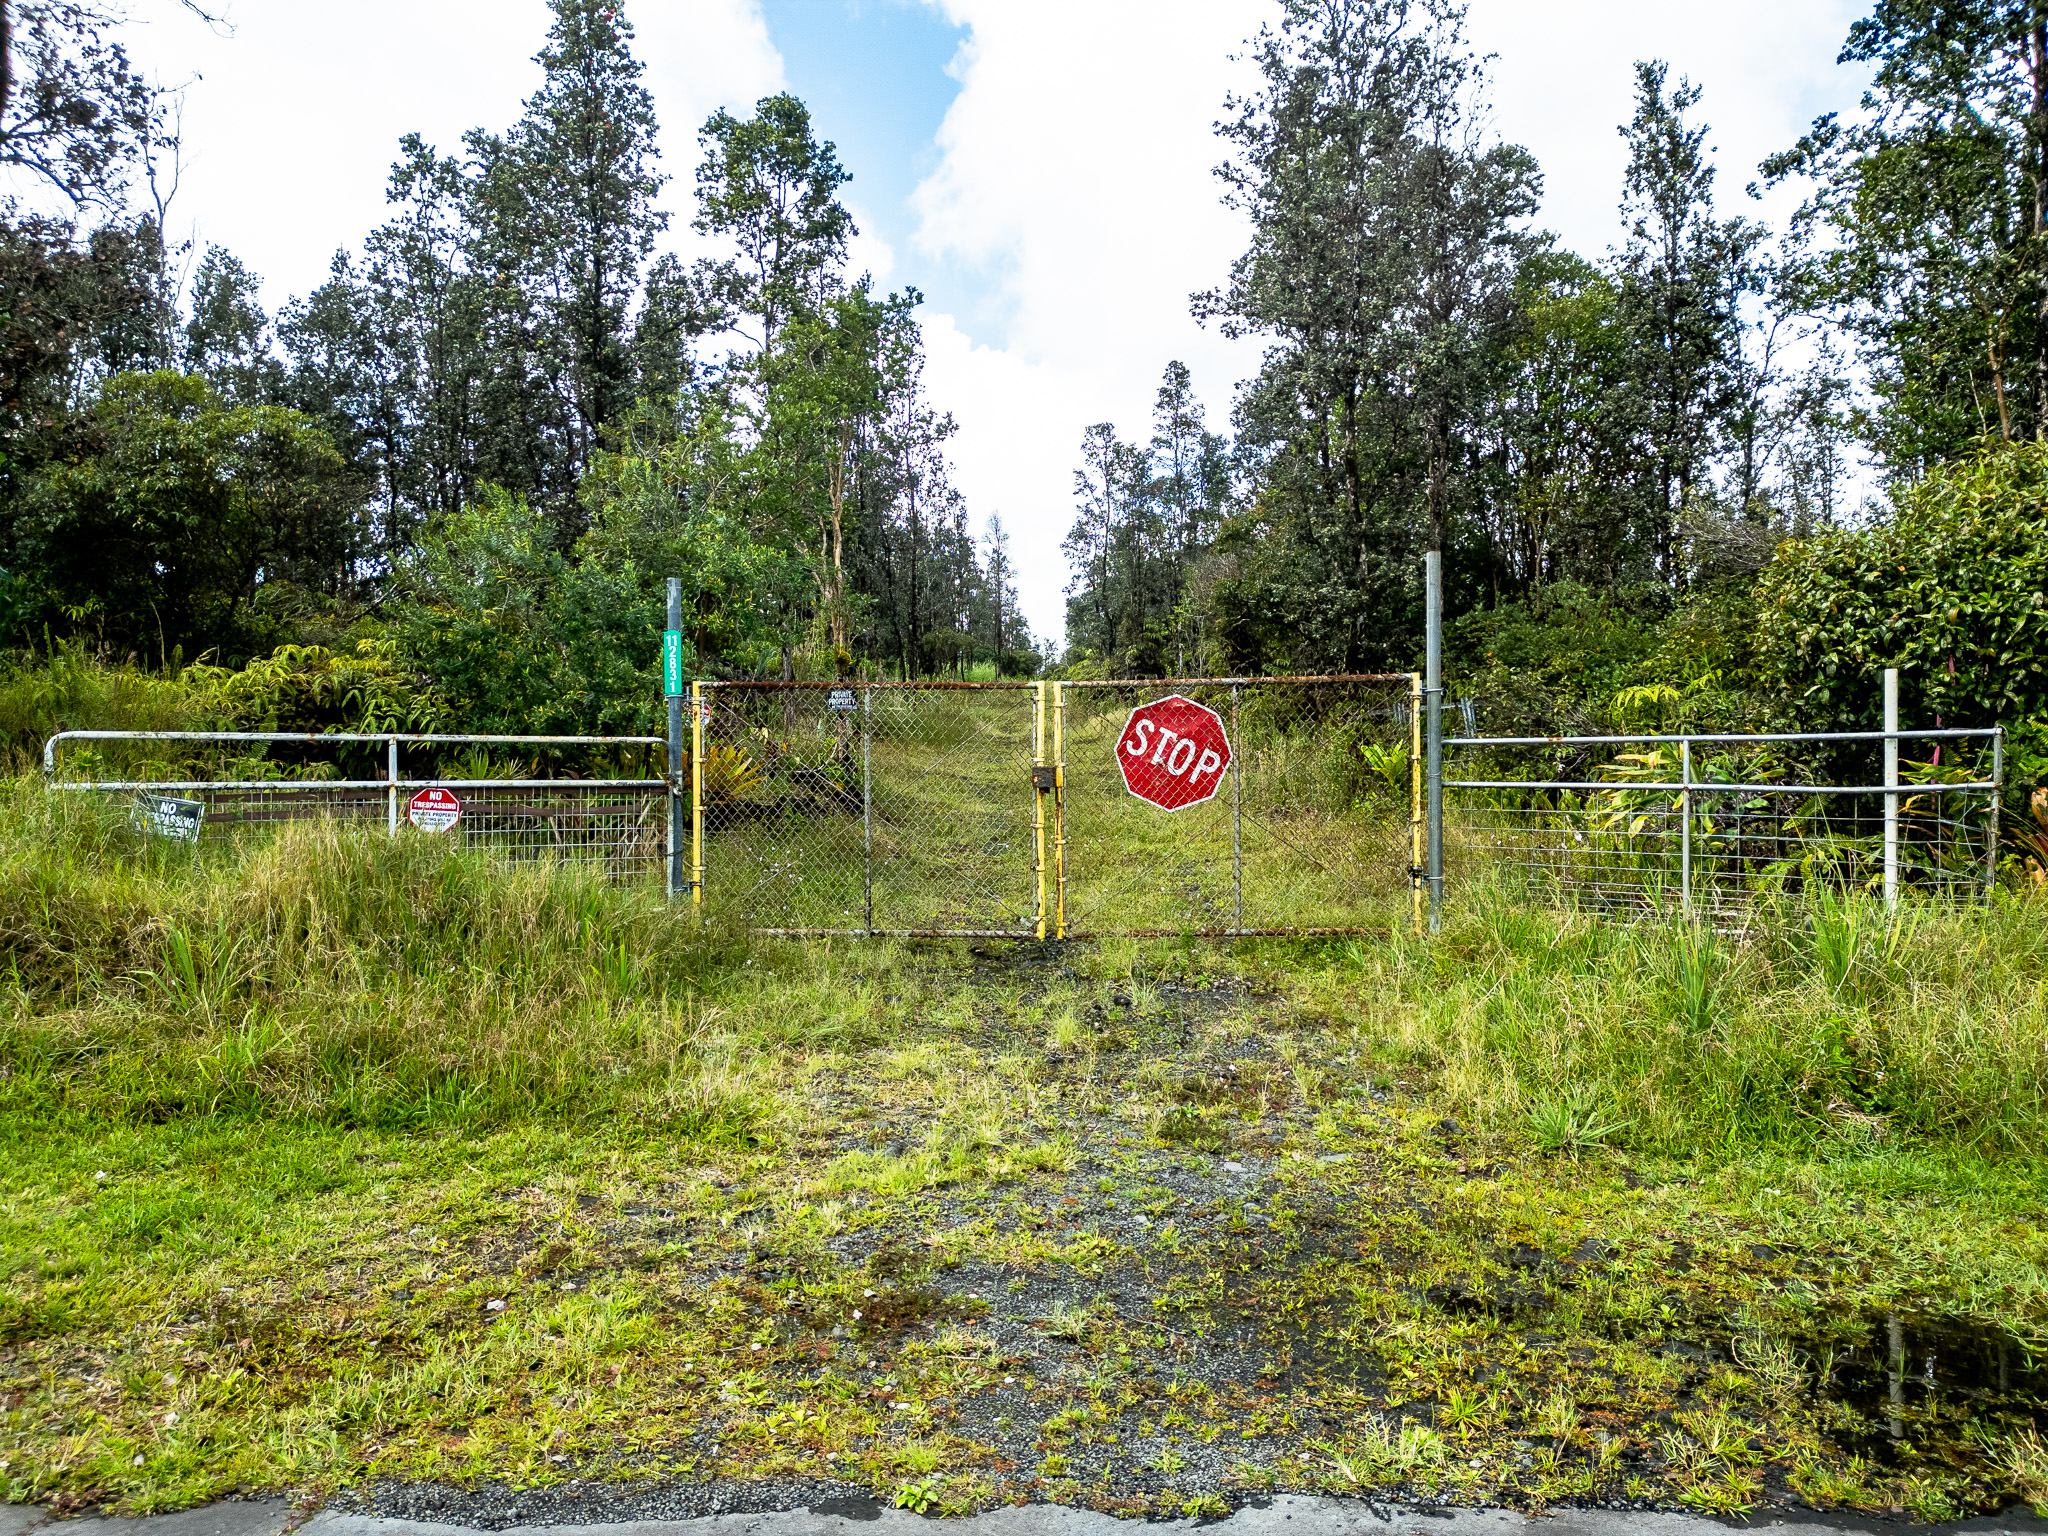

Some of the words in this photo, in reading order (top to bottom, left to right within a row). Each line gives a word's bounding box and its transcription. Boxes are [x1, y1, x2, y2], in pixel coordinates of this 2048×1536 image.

[665, 634, 677, 693] 112831
[831, 690, 853, 698] PRIVATE
[1126, 718, 1221, 784] STOP
[429, 791, 443, 800] NO
[160, 801, 177, 814] NO
[413, 801, 457, 810] TRESPASSING
[146, 811, 195, 829] SPASSING
